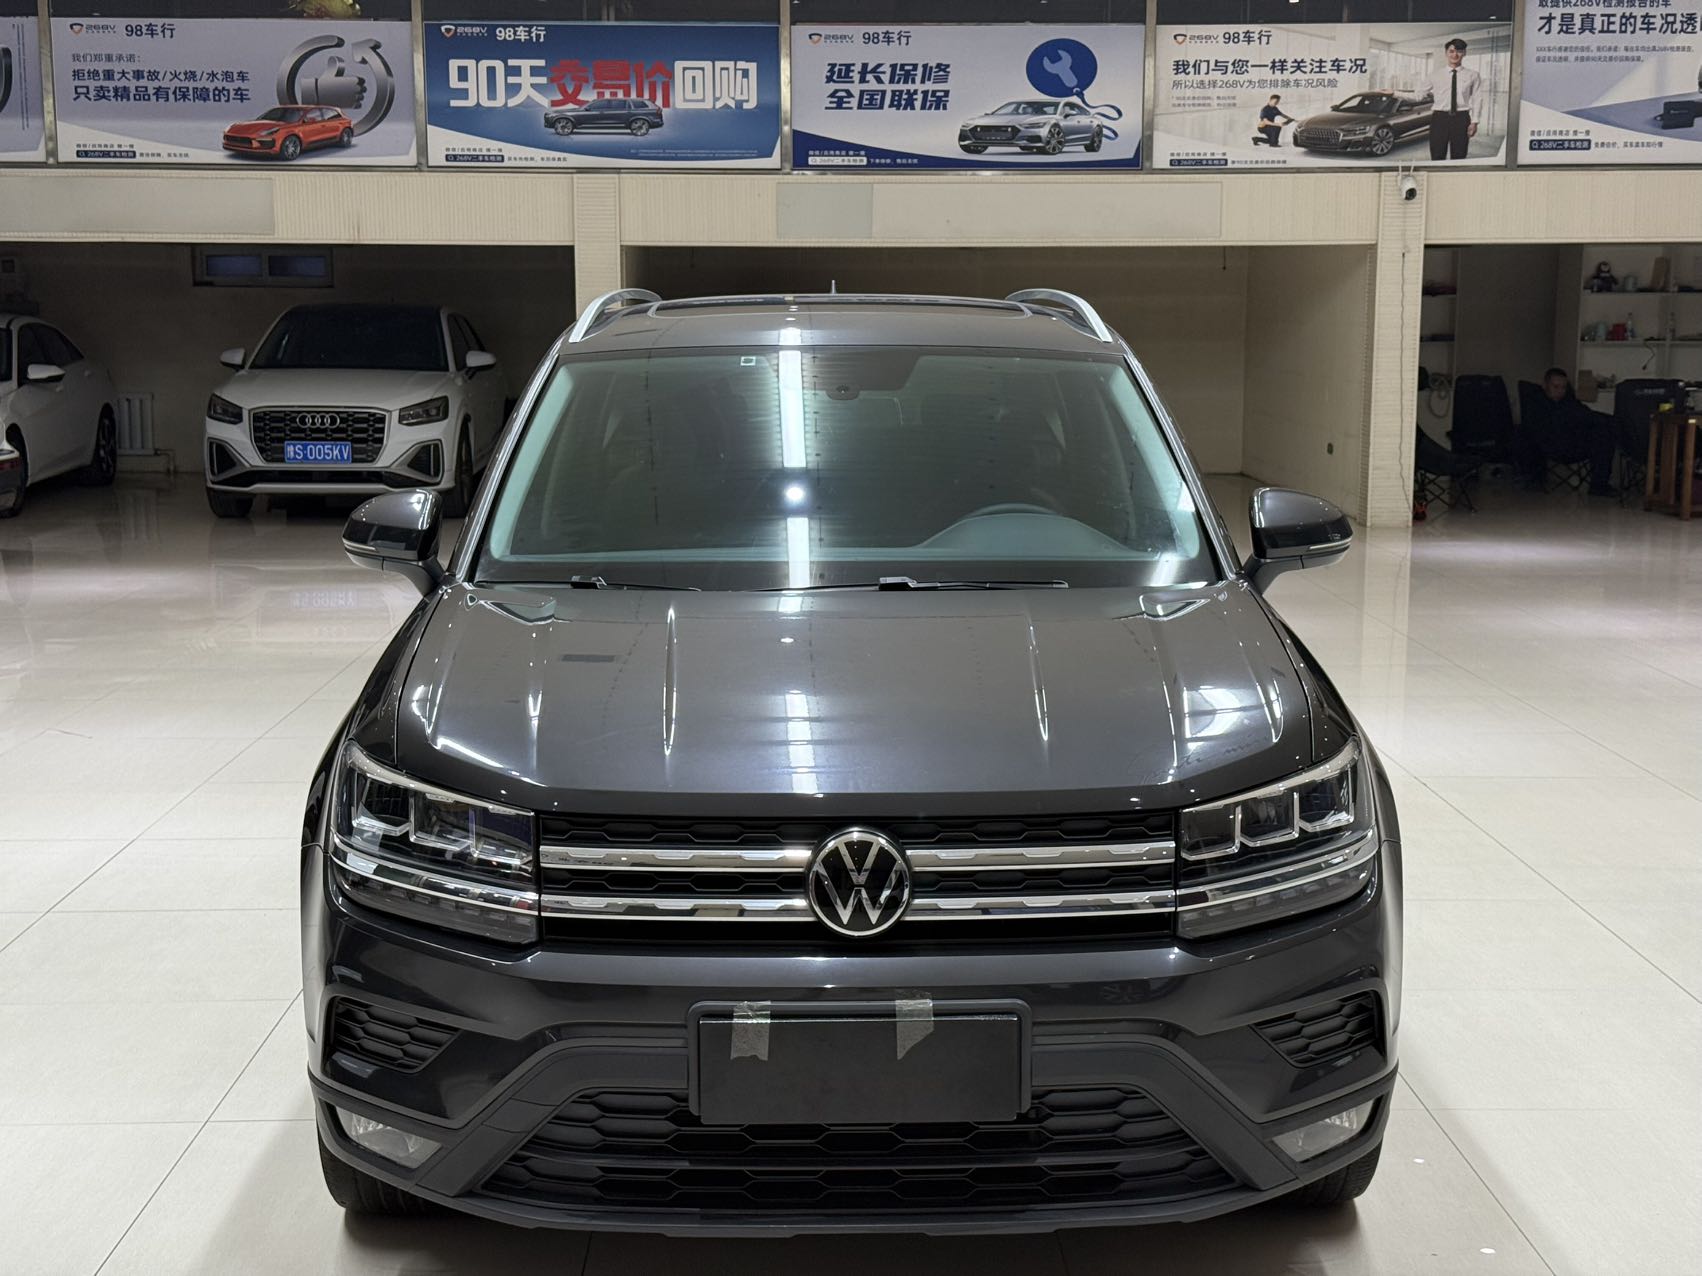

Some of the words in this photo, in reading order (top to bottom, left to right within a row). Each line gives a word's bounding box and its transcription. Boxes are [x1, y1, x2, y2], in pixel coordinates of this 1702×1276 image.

[125, 23, 176, 39] 98车行
[1537, 12, 1702, 35] 才是真正的车况透
[496, 26, 546, 43] 98车行
[862, 31, 912, 46] 98车行
[1222, 30, 1272, 45] 98车行
[825, 63, 951, 85] 延长保修
[1172, 58, 1368, 75] 我们与您一样关注车况
[72, 69, 250, 83] 拒绝重大事故/火烧/水泡车
[448, 59, 758, 109] 90天交易价回购
[1171, 78, 1339, 90] 所以选择268V为您排除车况风险
[73, 85, 250, 104] 只卖精品有保障的车
[825, 89, 950, 110] 全国联保
